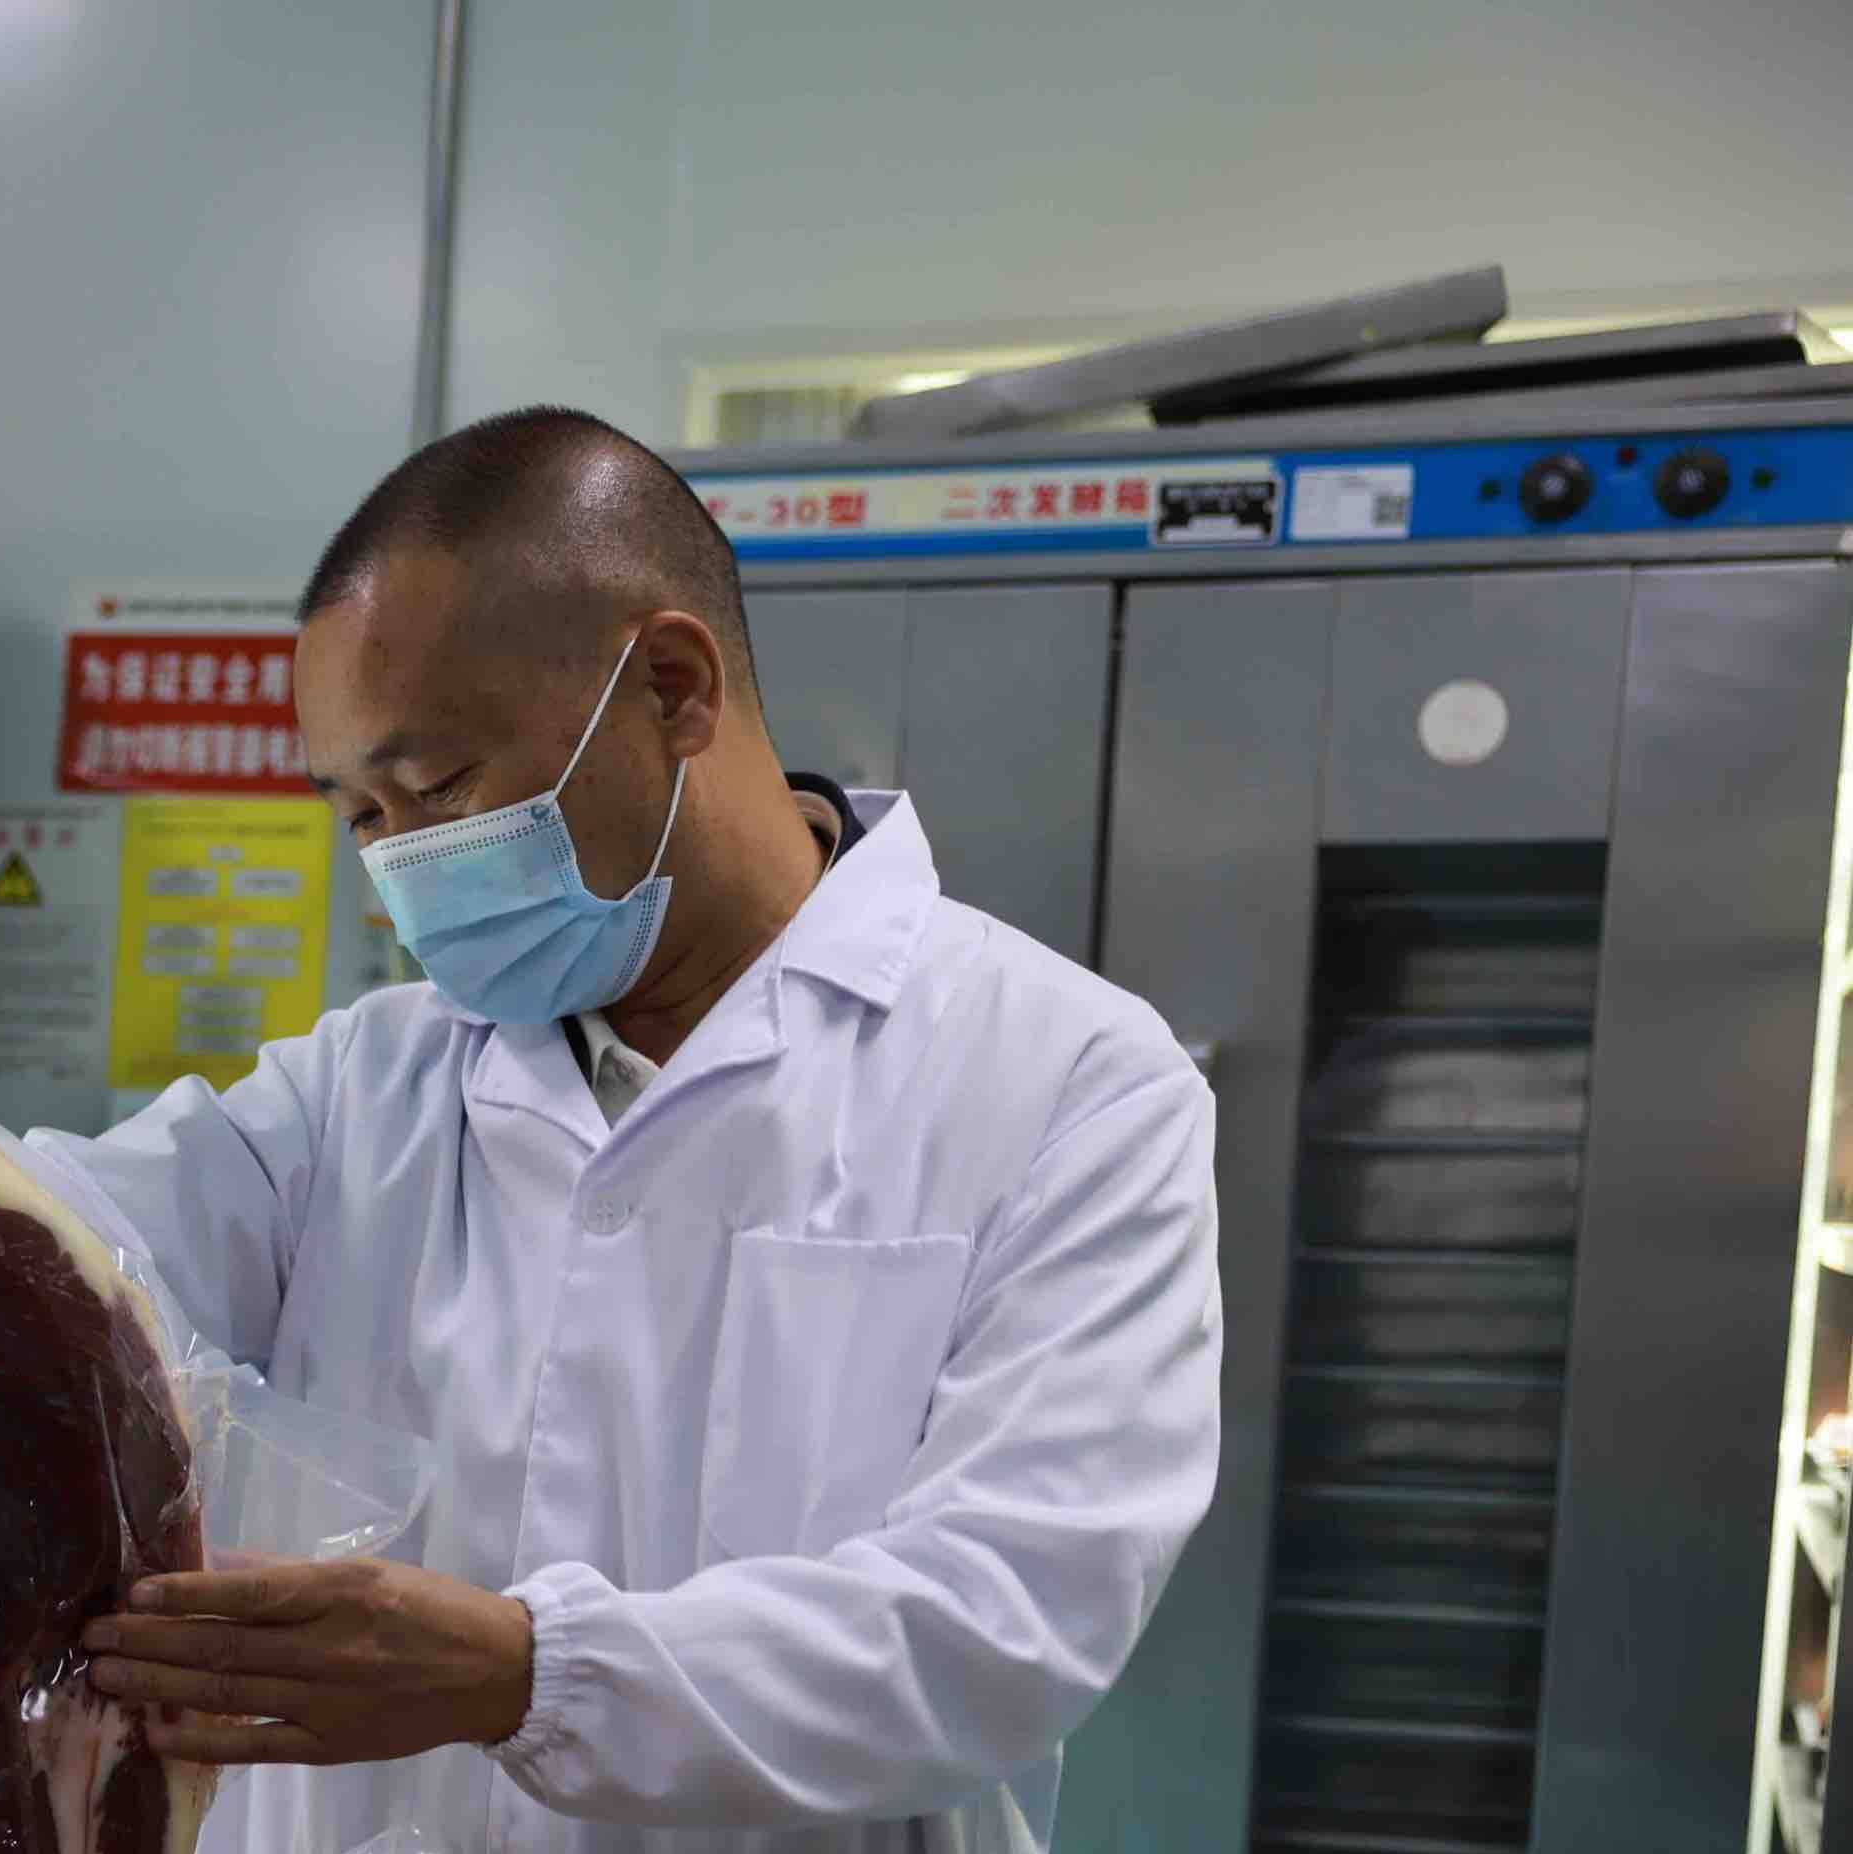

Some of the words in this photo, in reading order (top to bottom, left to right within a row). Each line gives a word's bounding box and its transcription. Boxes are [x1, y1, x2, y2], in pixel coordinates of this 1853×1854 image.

[943, 478, 1151, 522] 二次发酵箱
